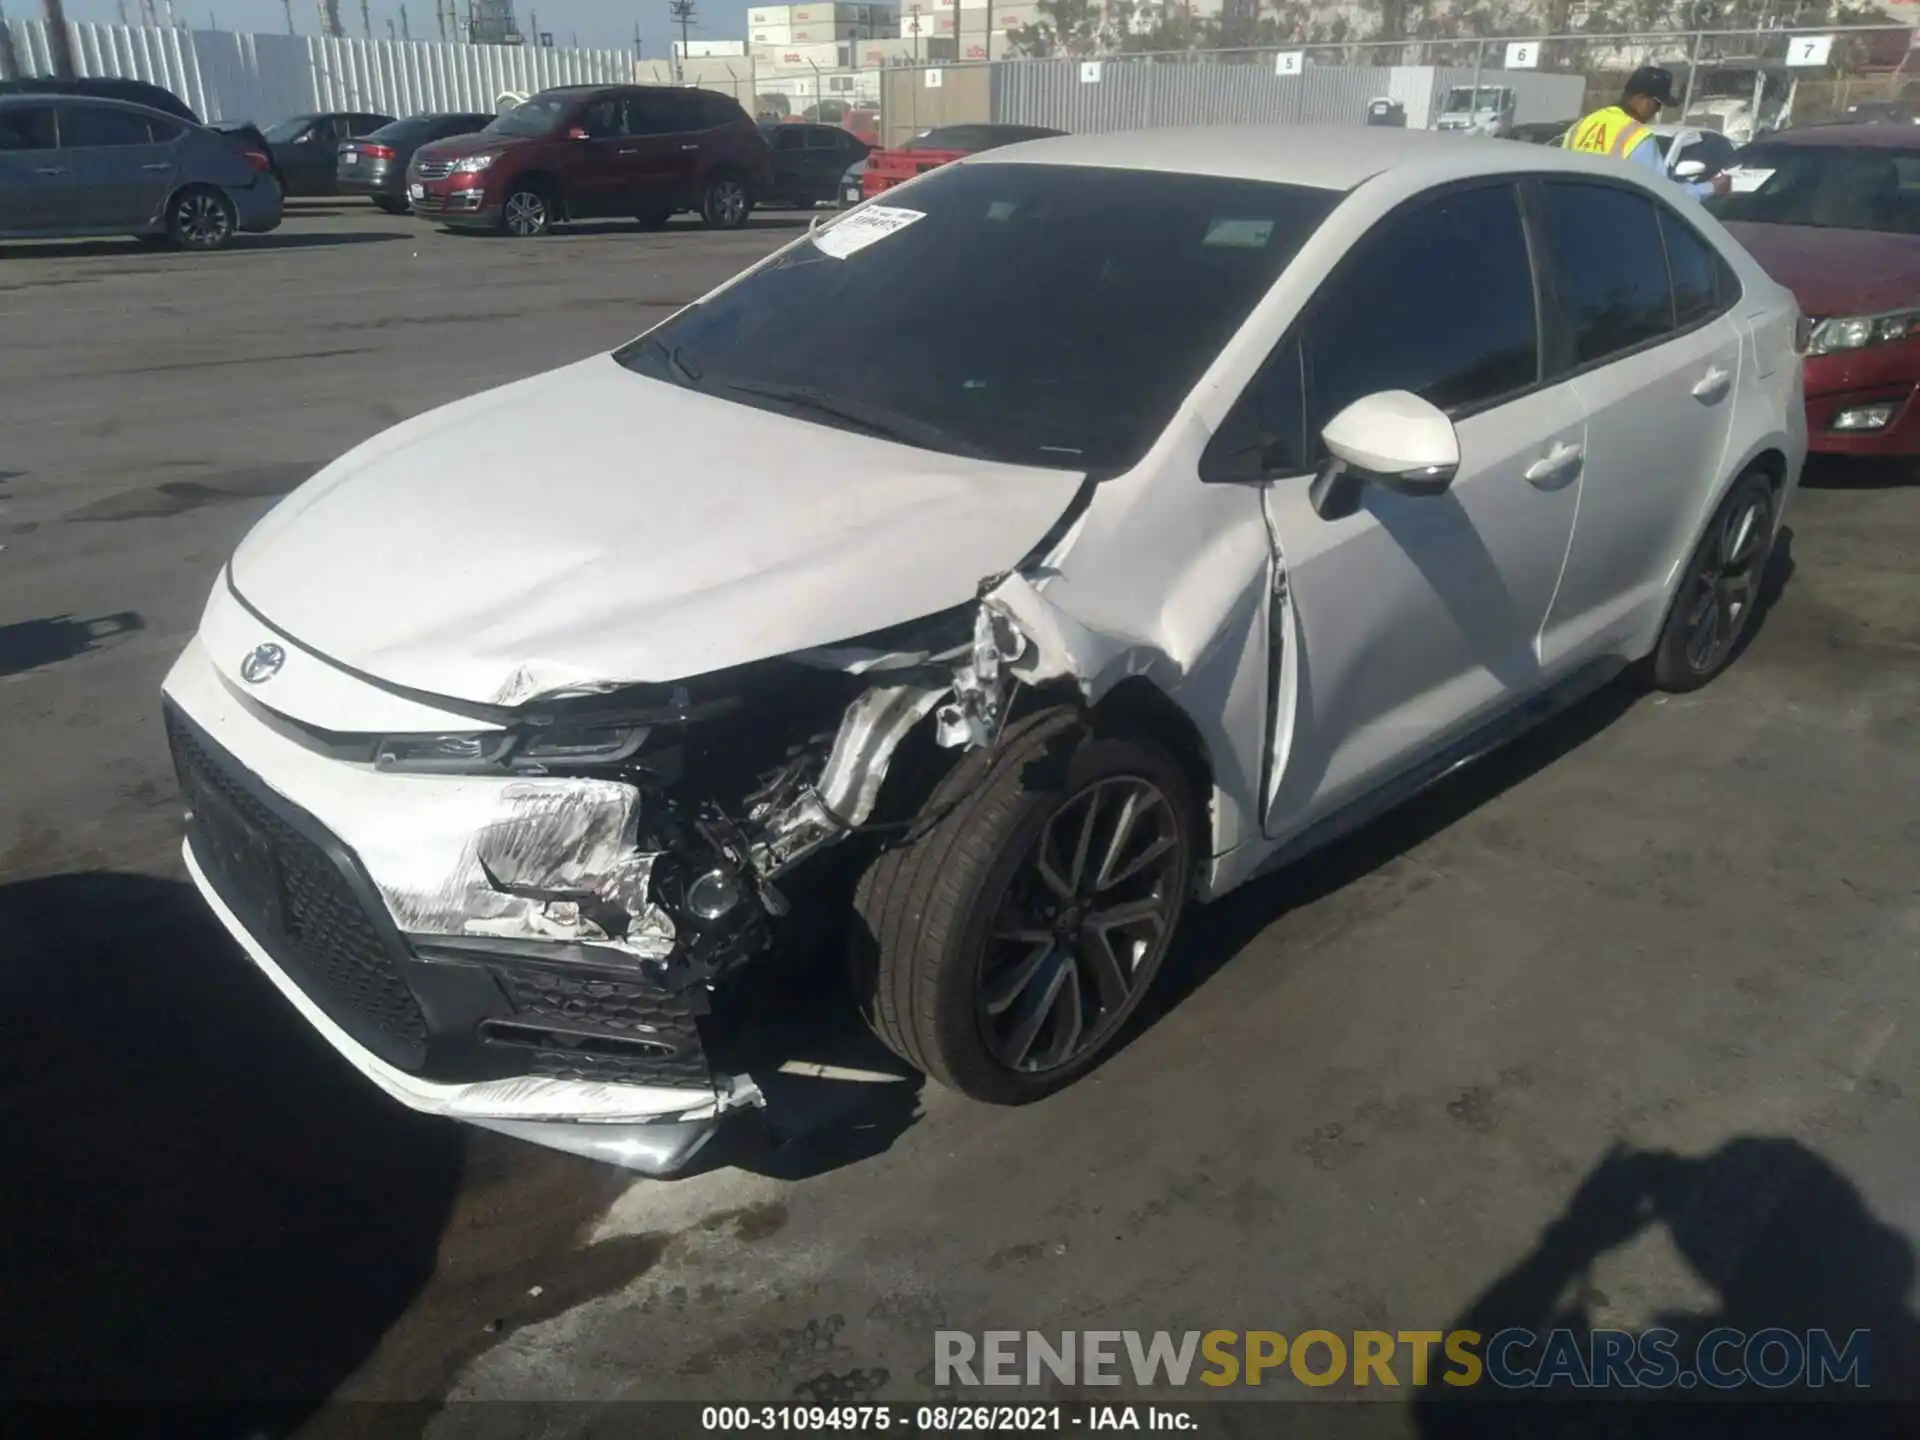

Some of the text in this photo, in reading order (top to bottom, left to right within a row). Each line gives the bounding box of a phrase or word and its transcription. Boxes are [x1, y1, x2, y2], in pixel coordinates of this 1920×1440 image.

[1517, 48, 1527, 62] 6
[1804, 43, 1815, 59] 7
[1285, 57, 1294, 70] 5
